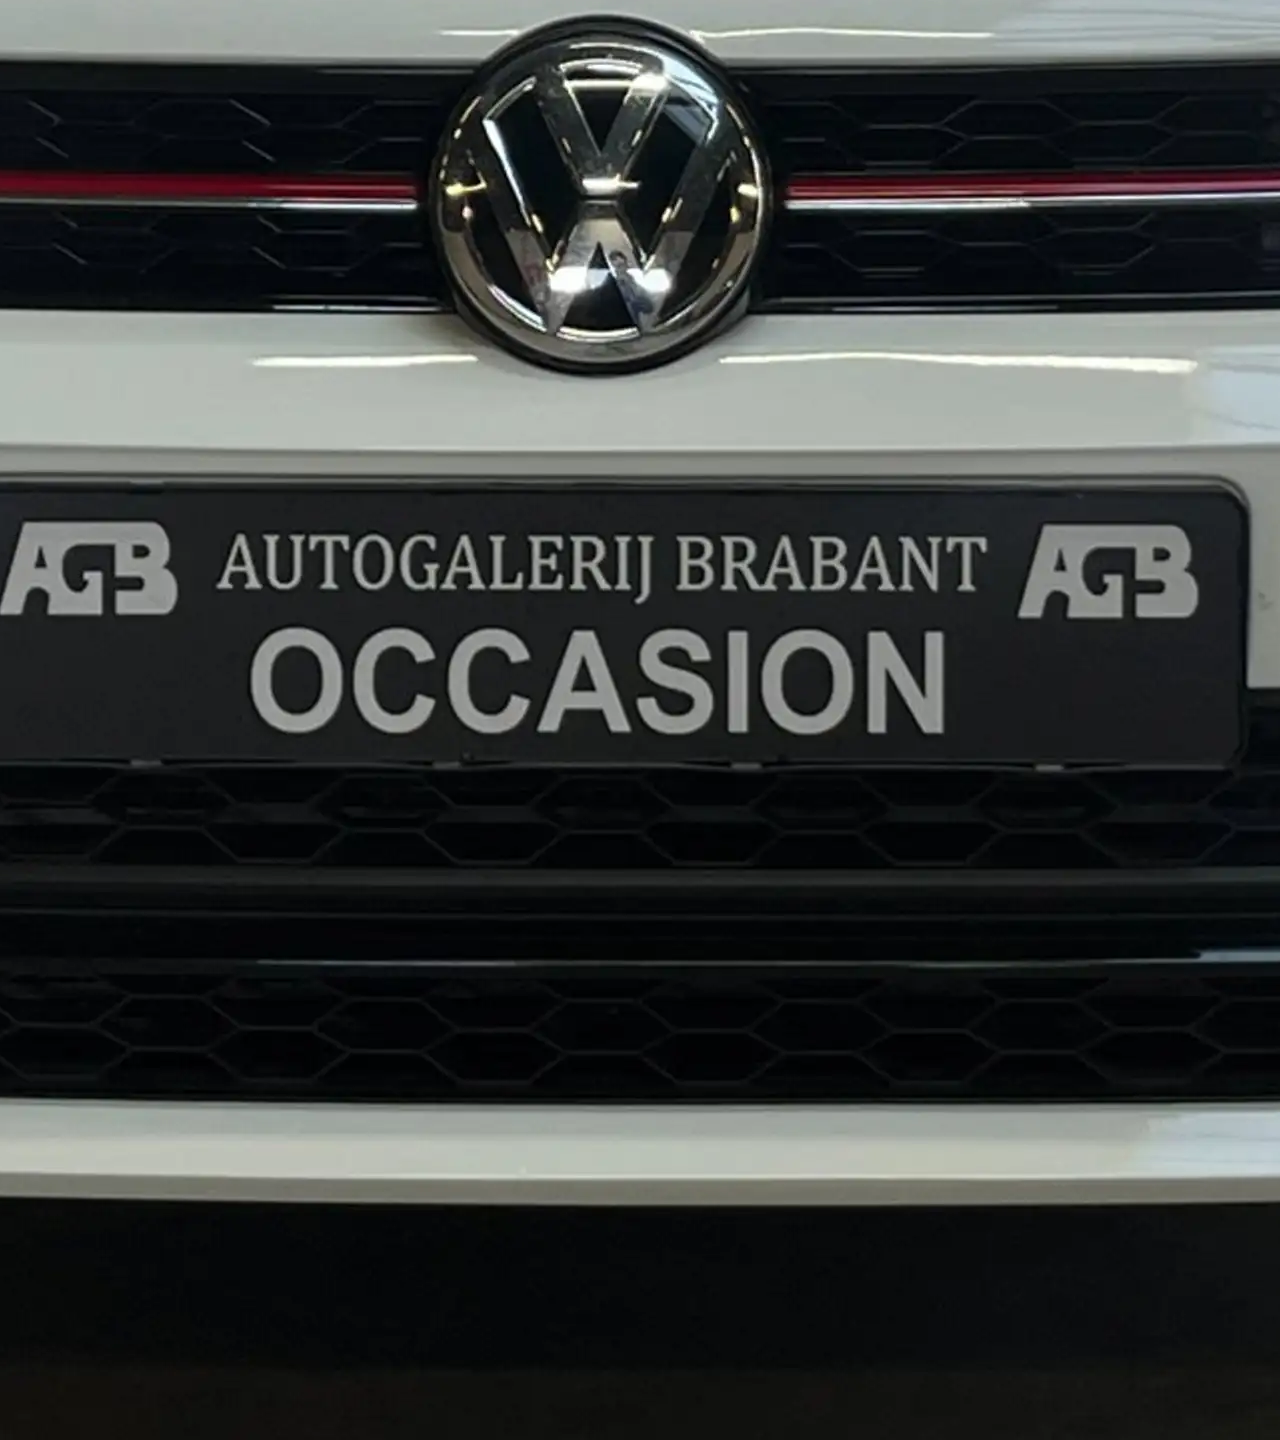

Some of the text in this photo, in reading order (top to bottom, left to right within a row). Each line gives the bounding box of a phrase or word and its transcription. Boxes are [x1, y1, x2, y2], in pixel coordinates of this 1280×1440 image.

[216, 533, 654, 605] AUTOGALERIJ
[676, 535, 988, 594] BRABANT
[1018, 523, 1199, 619] AGB
[250, 626, 945, 736] OCCASION
